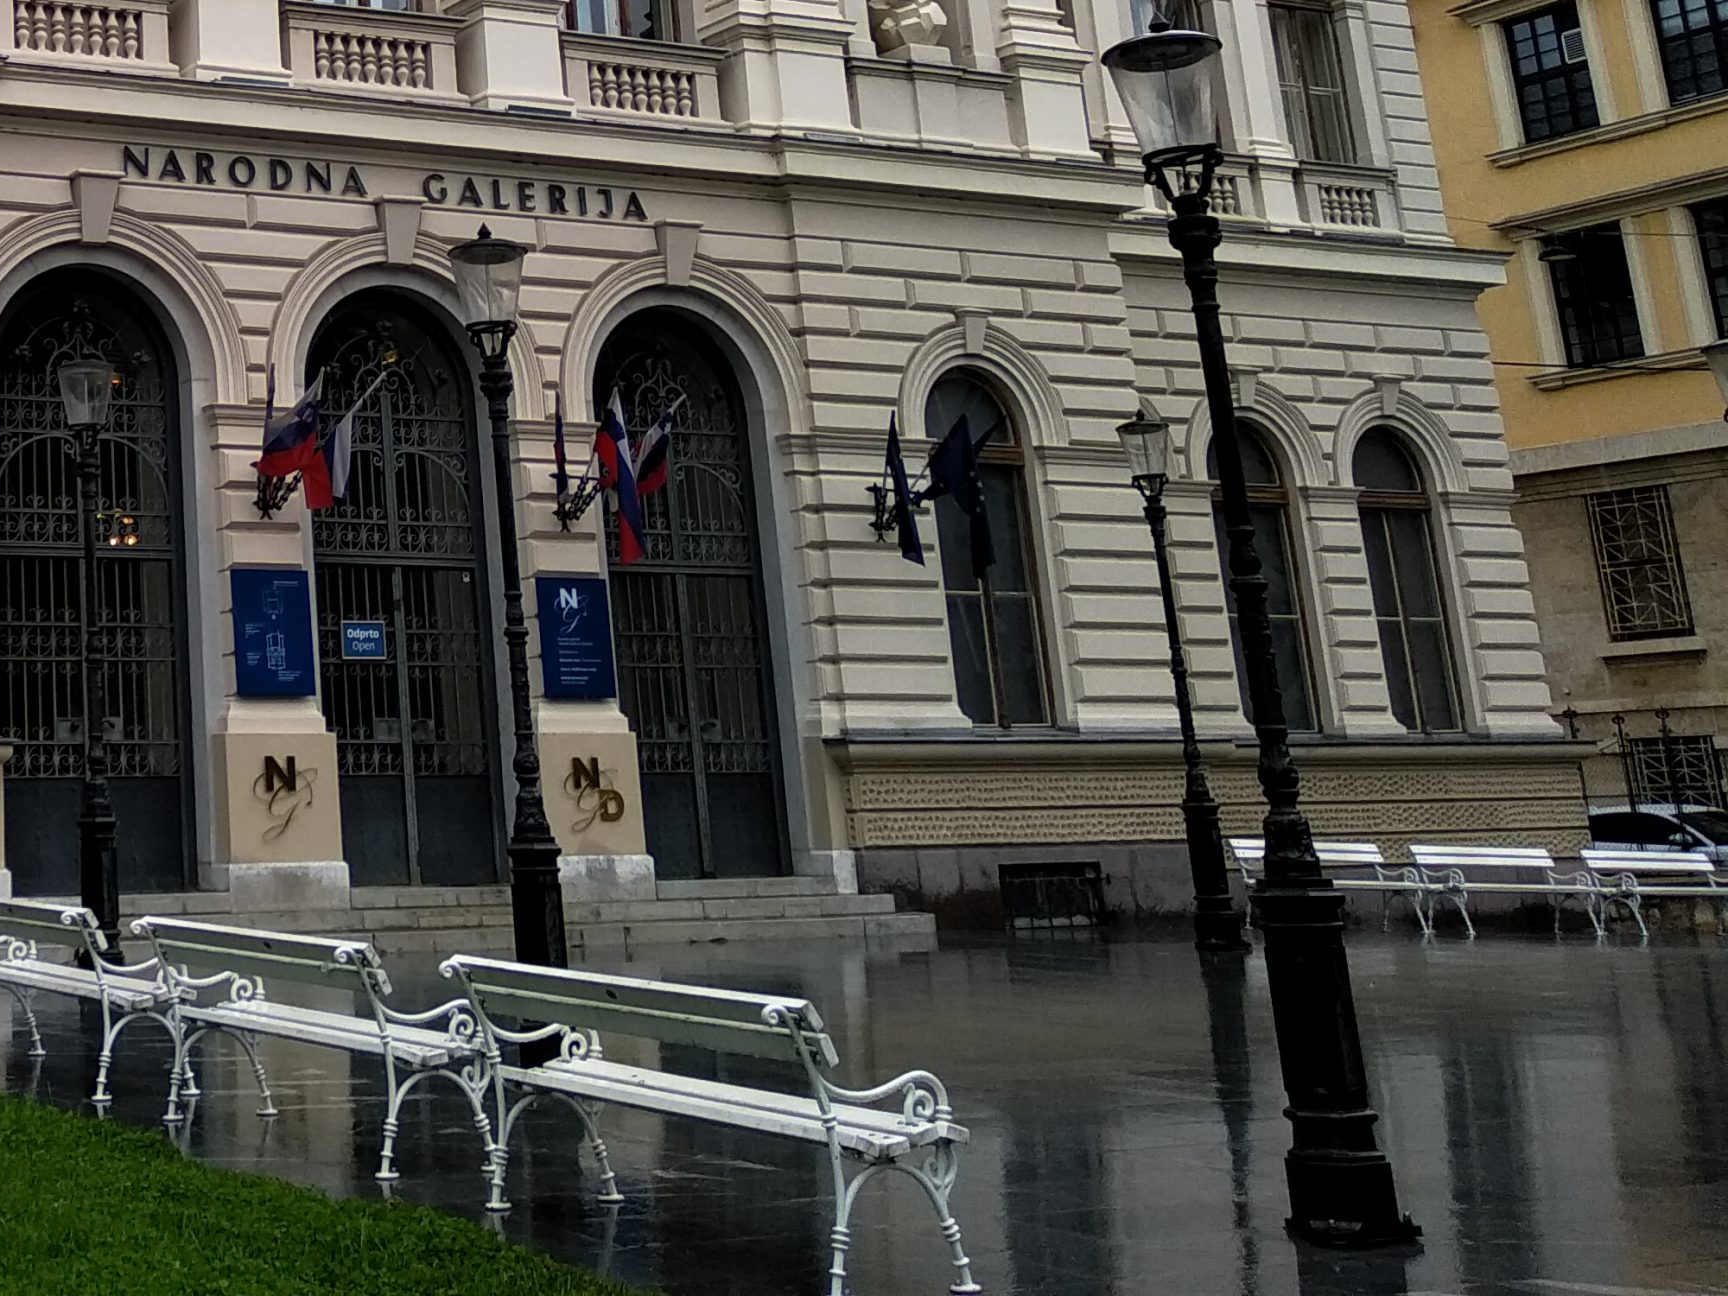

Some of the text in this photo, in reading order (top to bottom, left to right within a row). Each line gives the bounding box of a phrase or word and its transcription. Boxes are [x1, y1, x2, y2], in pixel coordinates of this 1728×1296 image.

[122, 145, 649, 222] NARODNA GALERIJA
[346, 628, 380, 640] Odprto
[352, 640, 376, 652] Open
